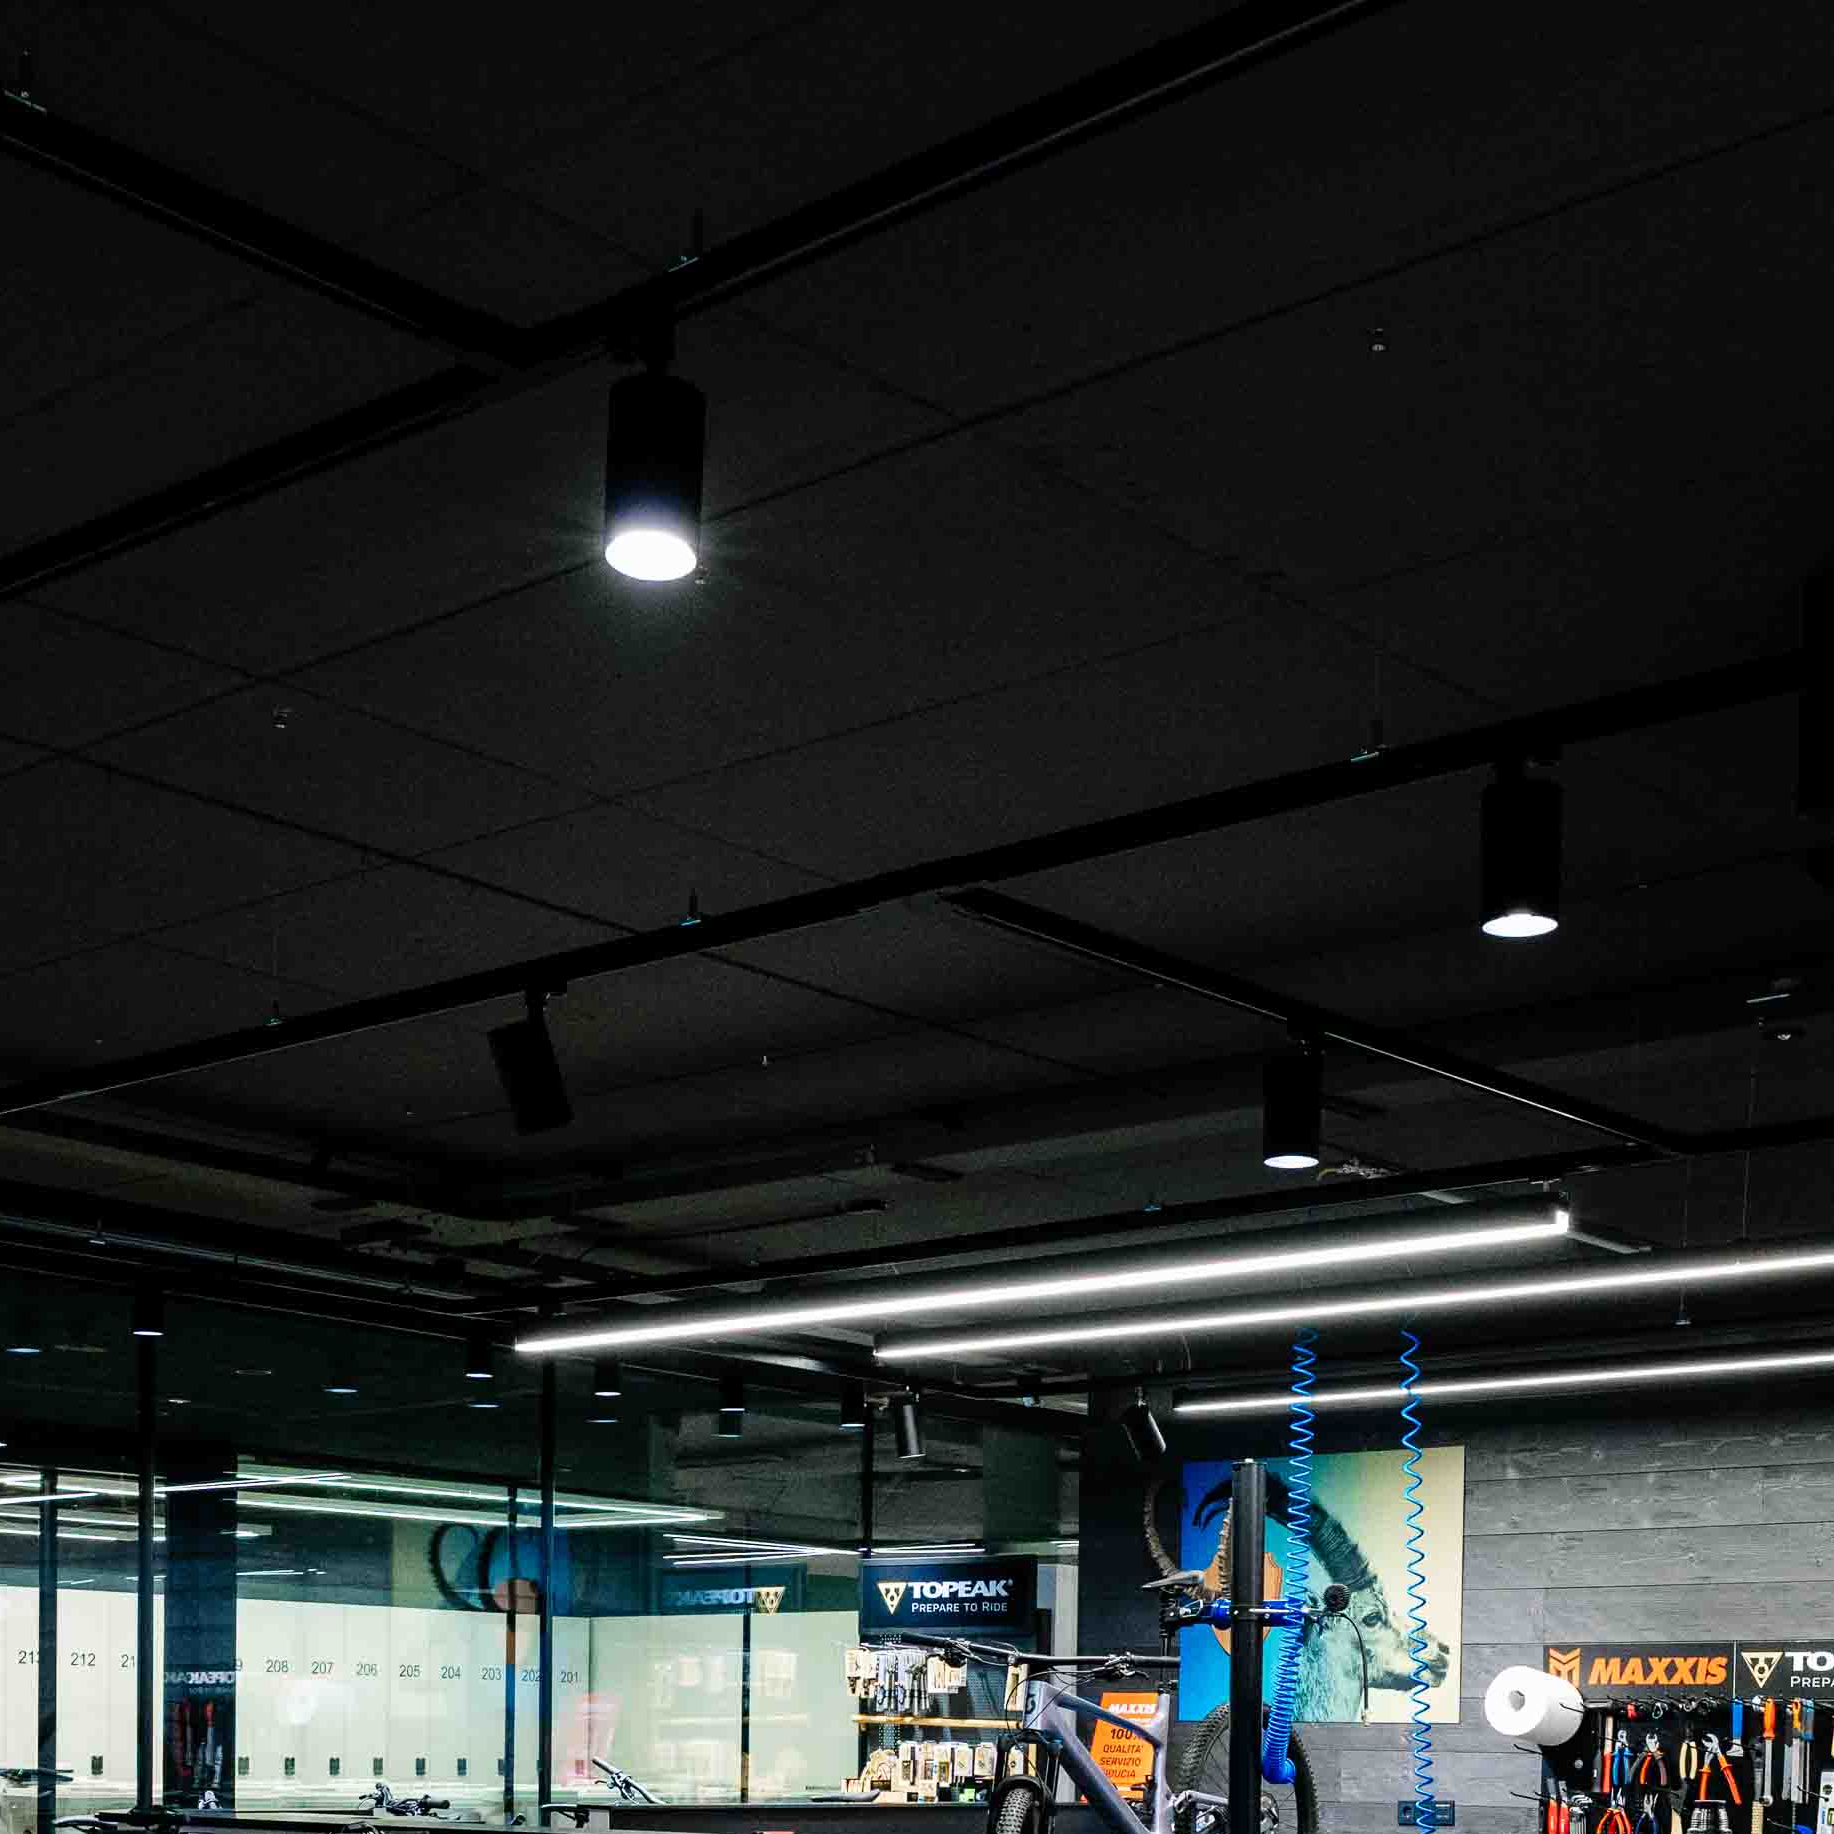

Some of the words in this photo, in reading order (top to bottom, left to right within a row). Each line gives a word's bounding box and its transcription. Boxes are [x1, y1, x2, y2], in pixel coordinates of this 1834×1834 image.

[908, 1580, 1005, 1599] TOPEAK
[70, 1653, 96, 1667] 212
[121, 1655, 135, 1668] 21
[266, 1659, 288, 1673] 208
[311, 1661, 334, 1675] 207
[356, 1663, 378, 1676] 206
[399, 1664, 421, 1678] 205
[441, 1666, 461, 1680] 204
[482, 1667, 502, 1681] 203
[1588, 1656, 1729, 1686] MAXXIS
[522, 1669, 544, 1682] 202
[560, 1671, 579, 1683] 201
[1104, 1769, 1136, 1778] IDUCIA
